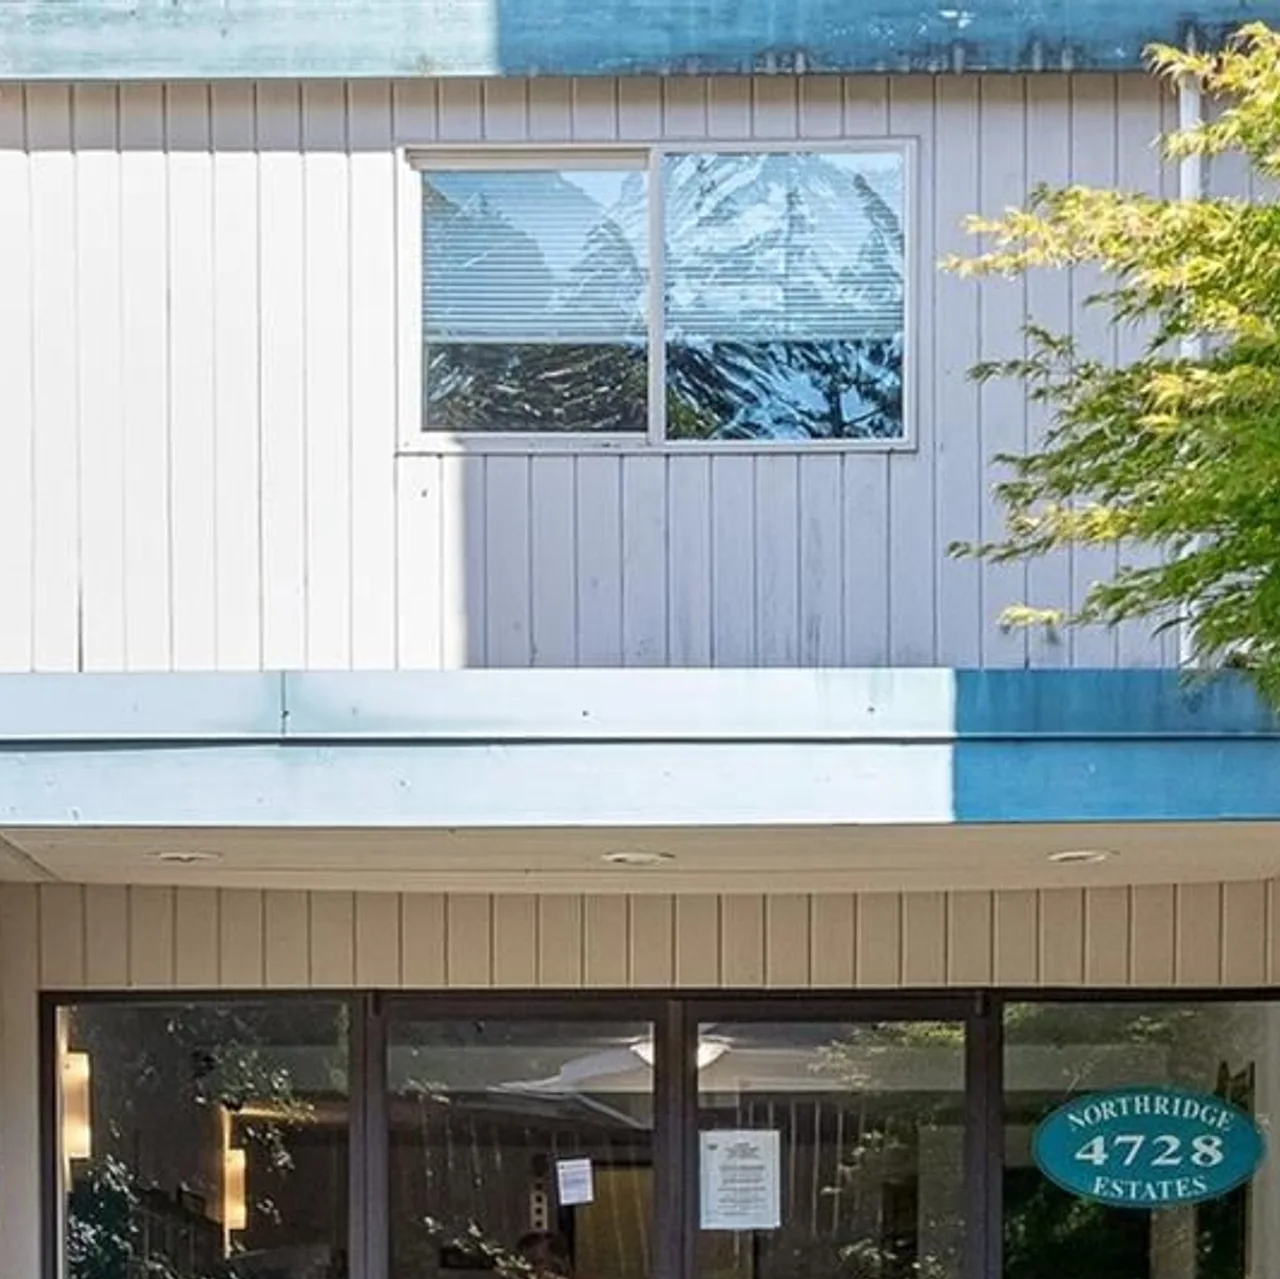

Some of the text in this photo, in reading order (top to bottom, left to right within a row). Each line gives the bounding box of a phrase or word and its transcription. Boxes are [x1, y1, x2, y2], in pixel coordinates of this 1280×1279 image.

[1067, 1094, 1235, 1132] NORTHRIDGE
[1074, 1134, 1224, 1167] 4728
[1091, 1175, 1208, 1200] ESTATES
